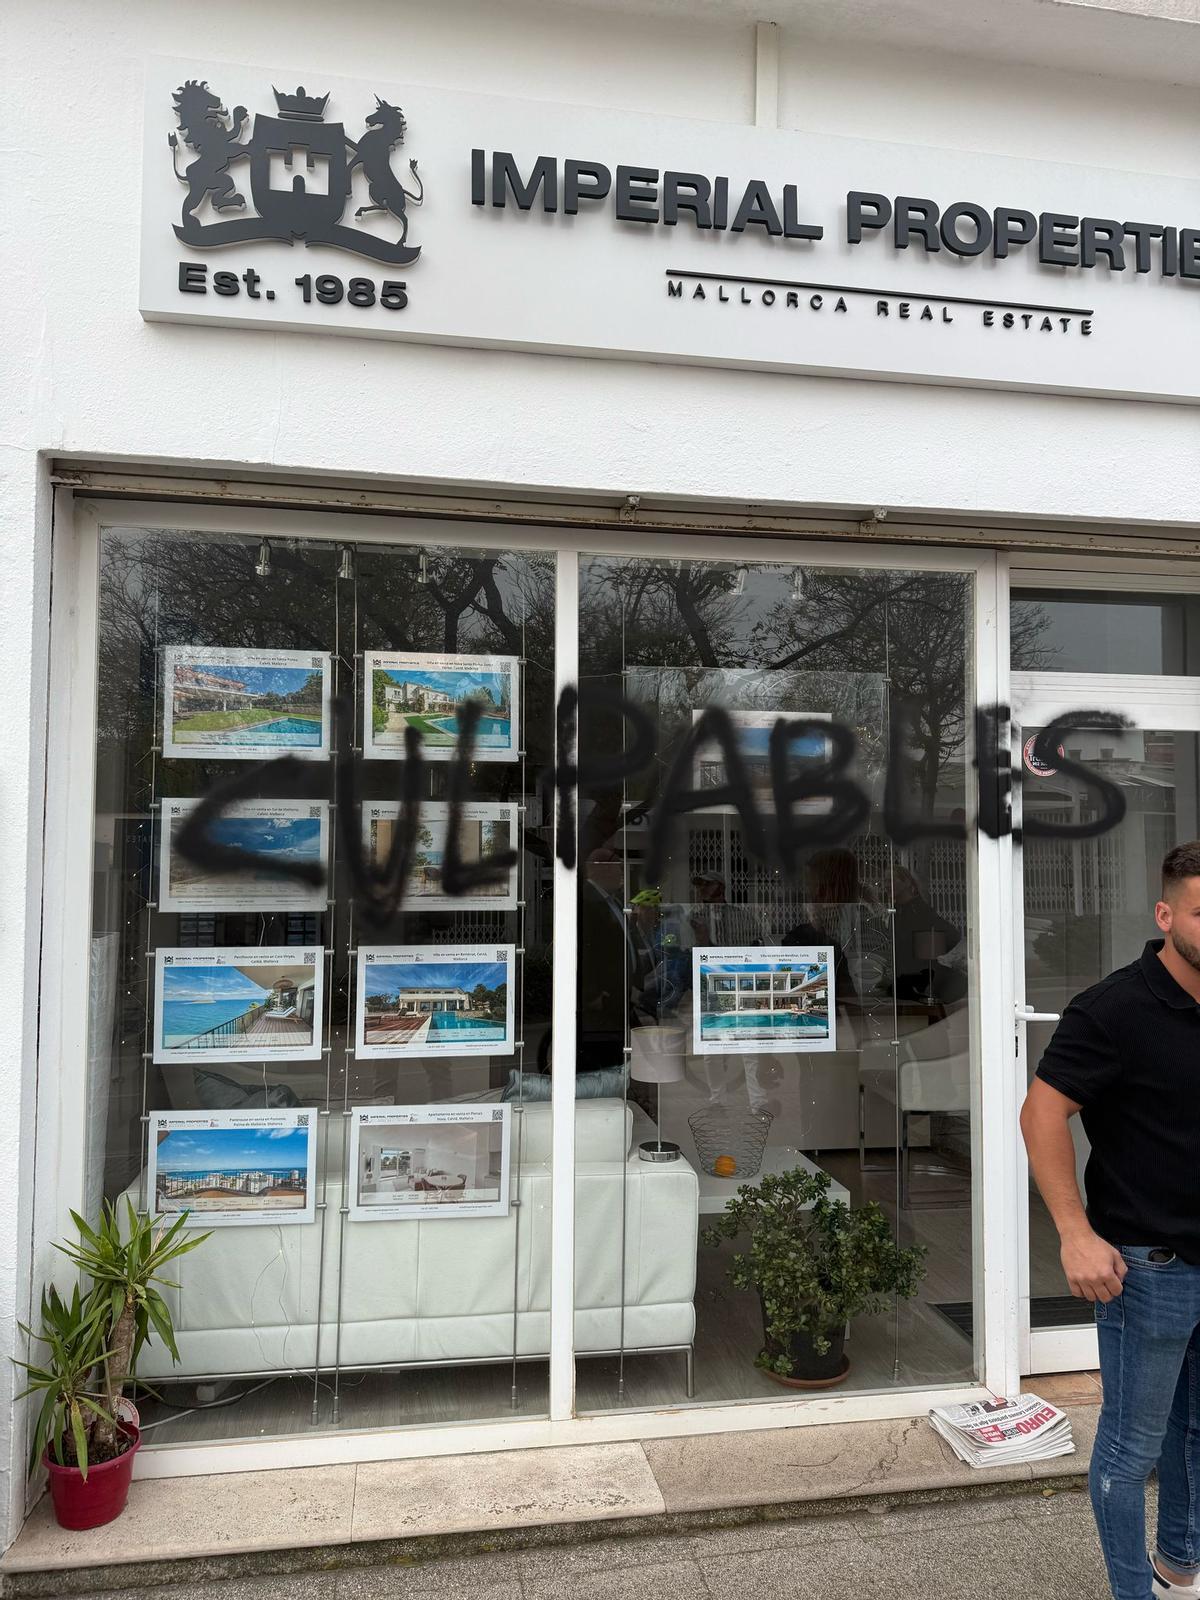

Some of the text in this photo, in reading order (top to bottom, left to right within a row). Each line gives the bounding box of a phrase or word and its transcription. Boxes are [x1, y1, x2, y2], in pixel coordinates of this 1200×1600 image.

[470, 148, 823, 241] IMPERIAL
[177, 261, 409, 310] Est. 1985
[667, 279, 1093, 336] MALLORCA REAL ESTATE
[173, 683, 1136, 922] CULPABLES
[1016, 1406, 1057, 1434] EURO
